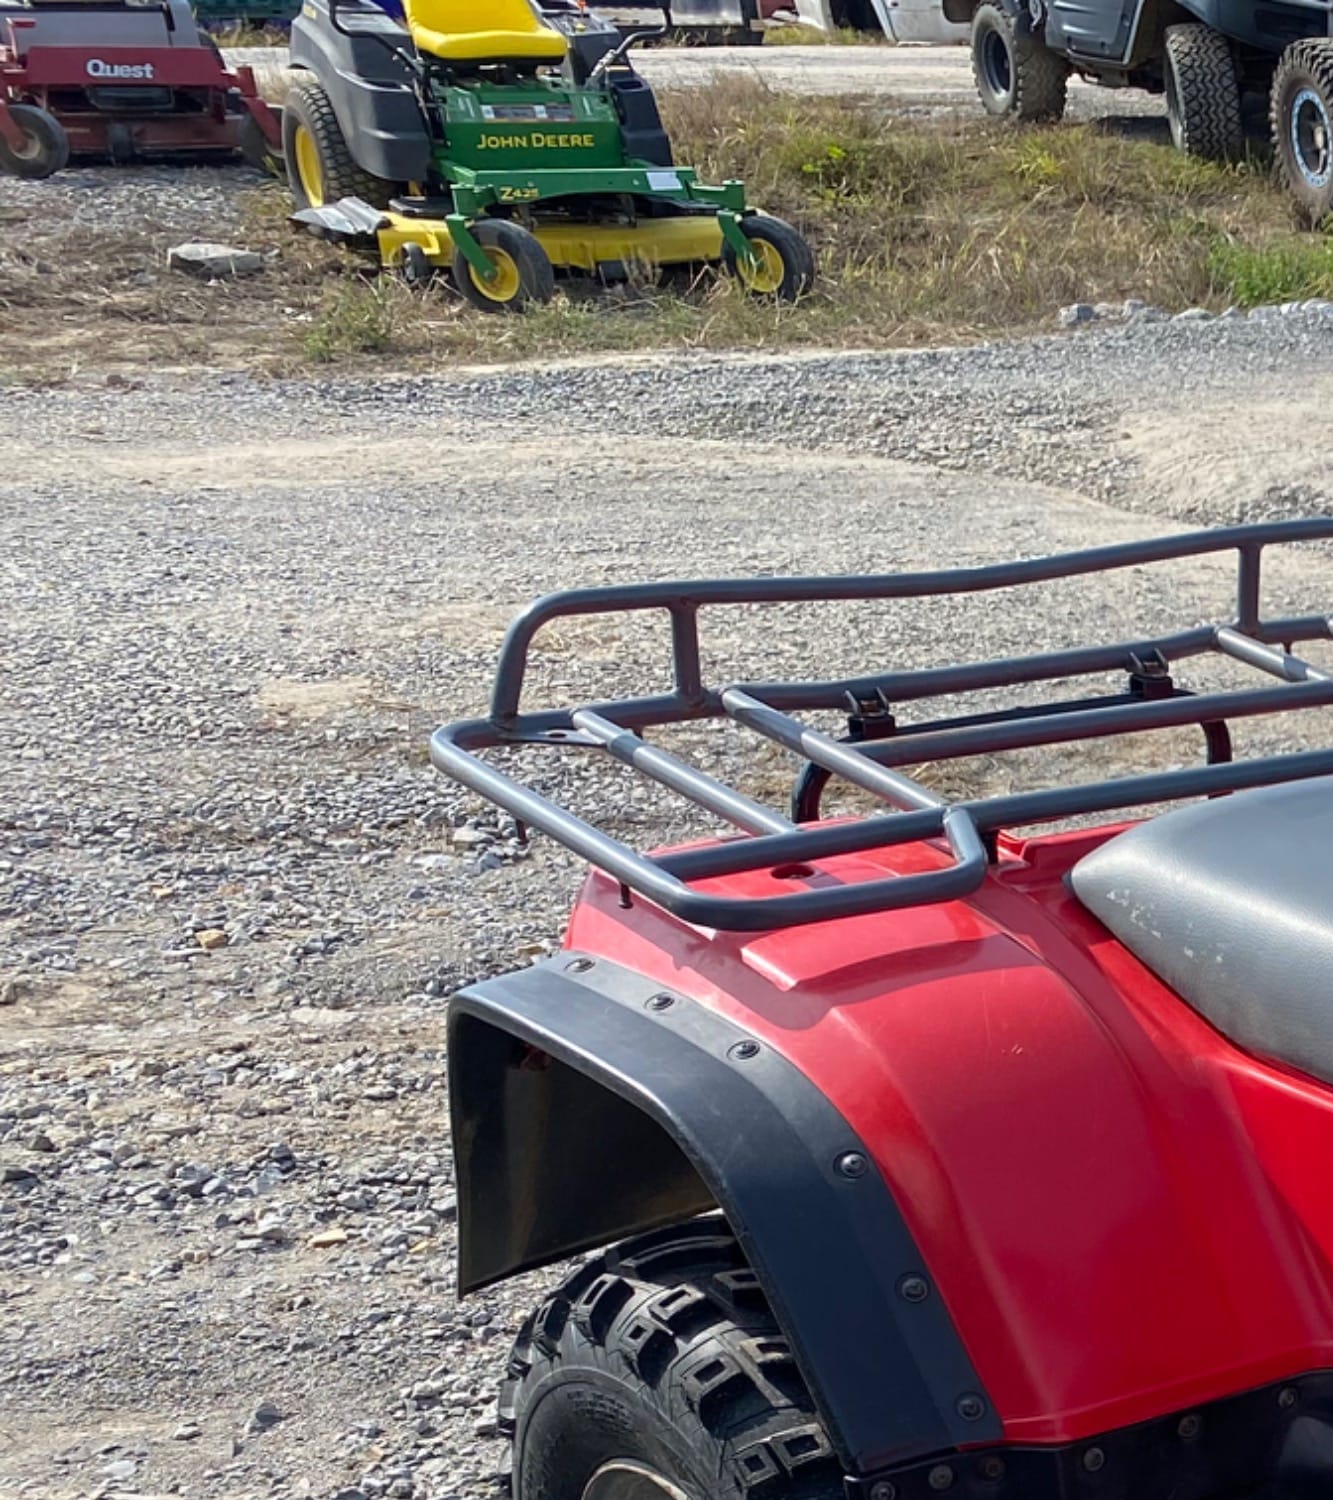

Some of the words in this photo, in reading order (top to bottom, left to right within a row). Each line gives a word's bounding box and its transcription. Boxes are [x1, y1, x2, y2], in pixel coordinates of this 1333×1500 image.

[86, 58, 154, 79] Quest
[477, 134, 528, 149] JOHN
[531, 132, 595, 148] DEERE
